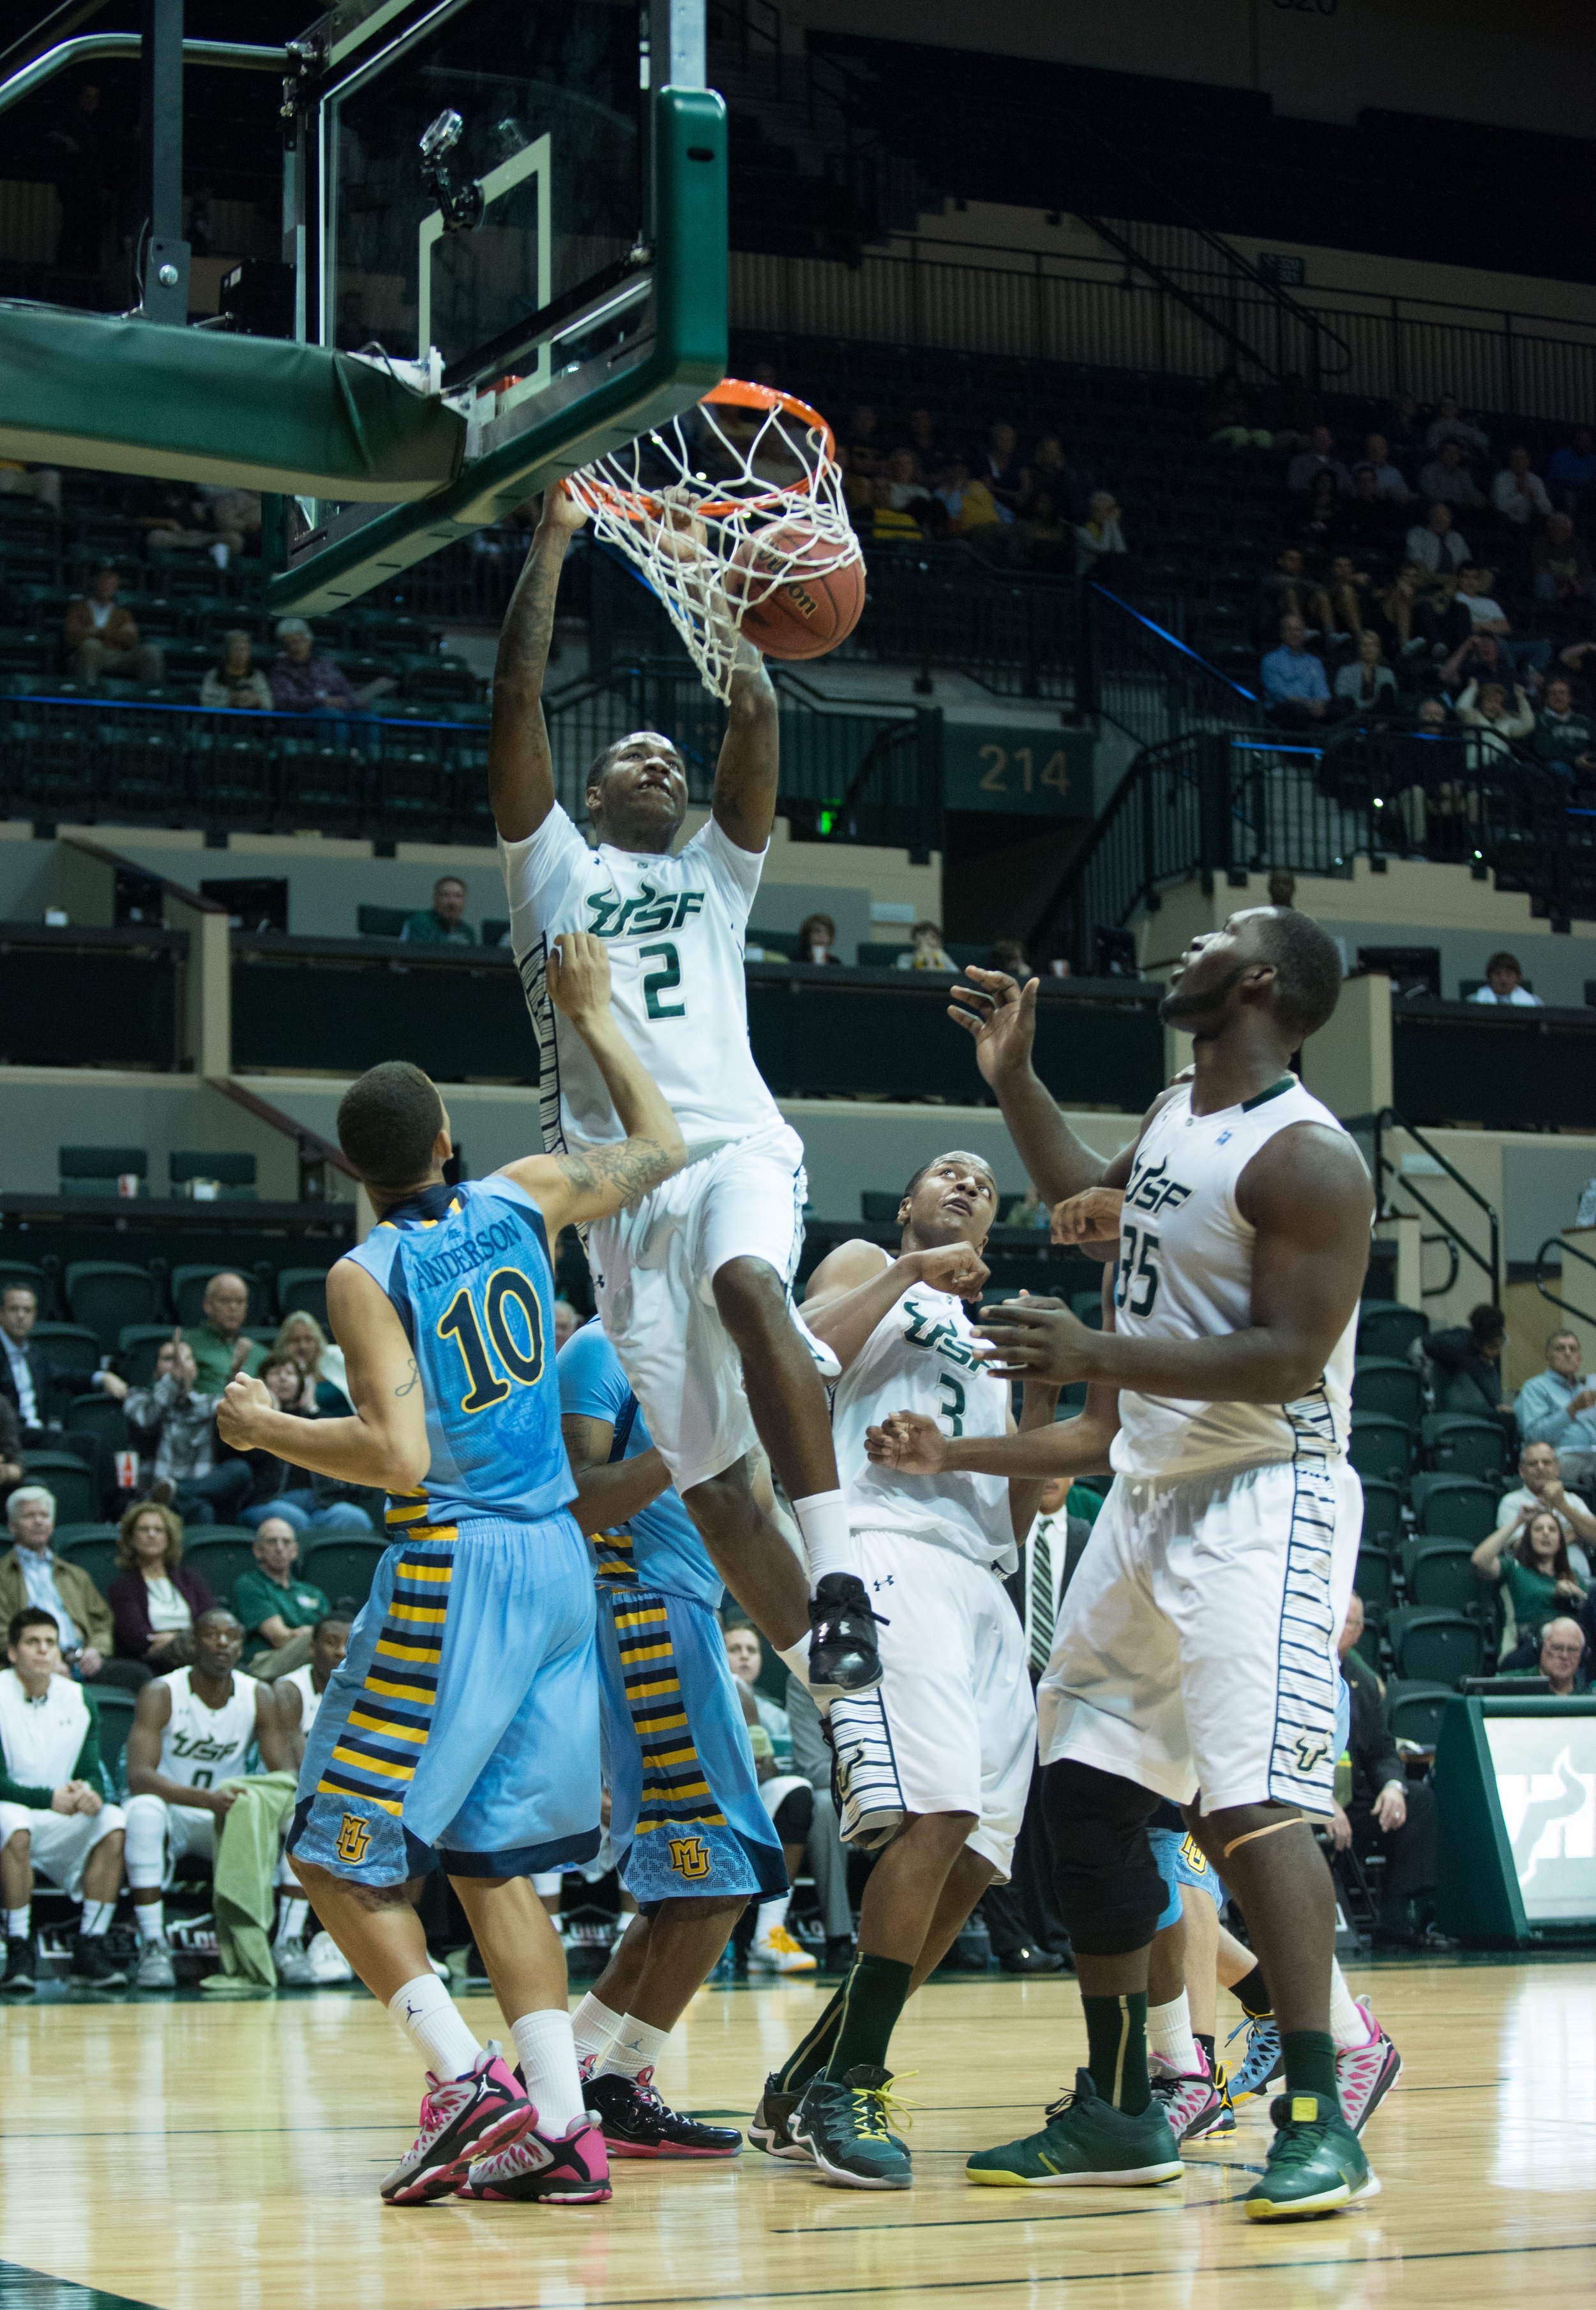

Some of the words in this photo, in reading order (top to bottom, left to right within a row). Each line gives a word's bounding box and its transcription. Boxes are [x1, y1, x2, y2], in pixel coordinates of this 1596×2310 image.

[753, 534, 818, 619] ilon
[978, 744, 1073, 796] 214
[584, 877, 707, 939] USF
[637, 940, 688, 1022] 2
[1125, 1151, 1195, 1216] USF
[414, 1215, 522, 1292] ANDERSON
[1117, 1223, 1161, 1318] 35
[437, 1267, 545, 1414] 10
[938, 1371, 966, 1437] 3
[172, 1728, 239, 1762] USF
[335, 1812, 373, 1865] MU
[668, 1836, 712, 1880] MU
